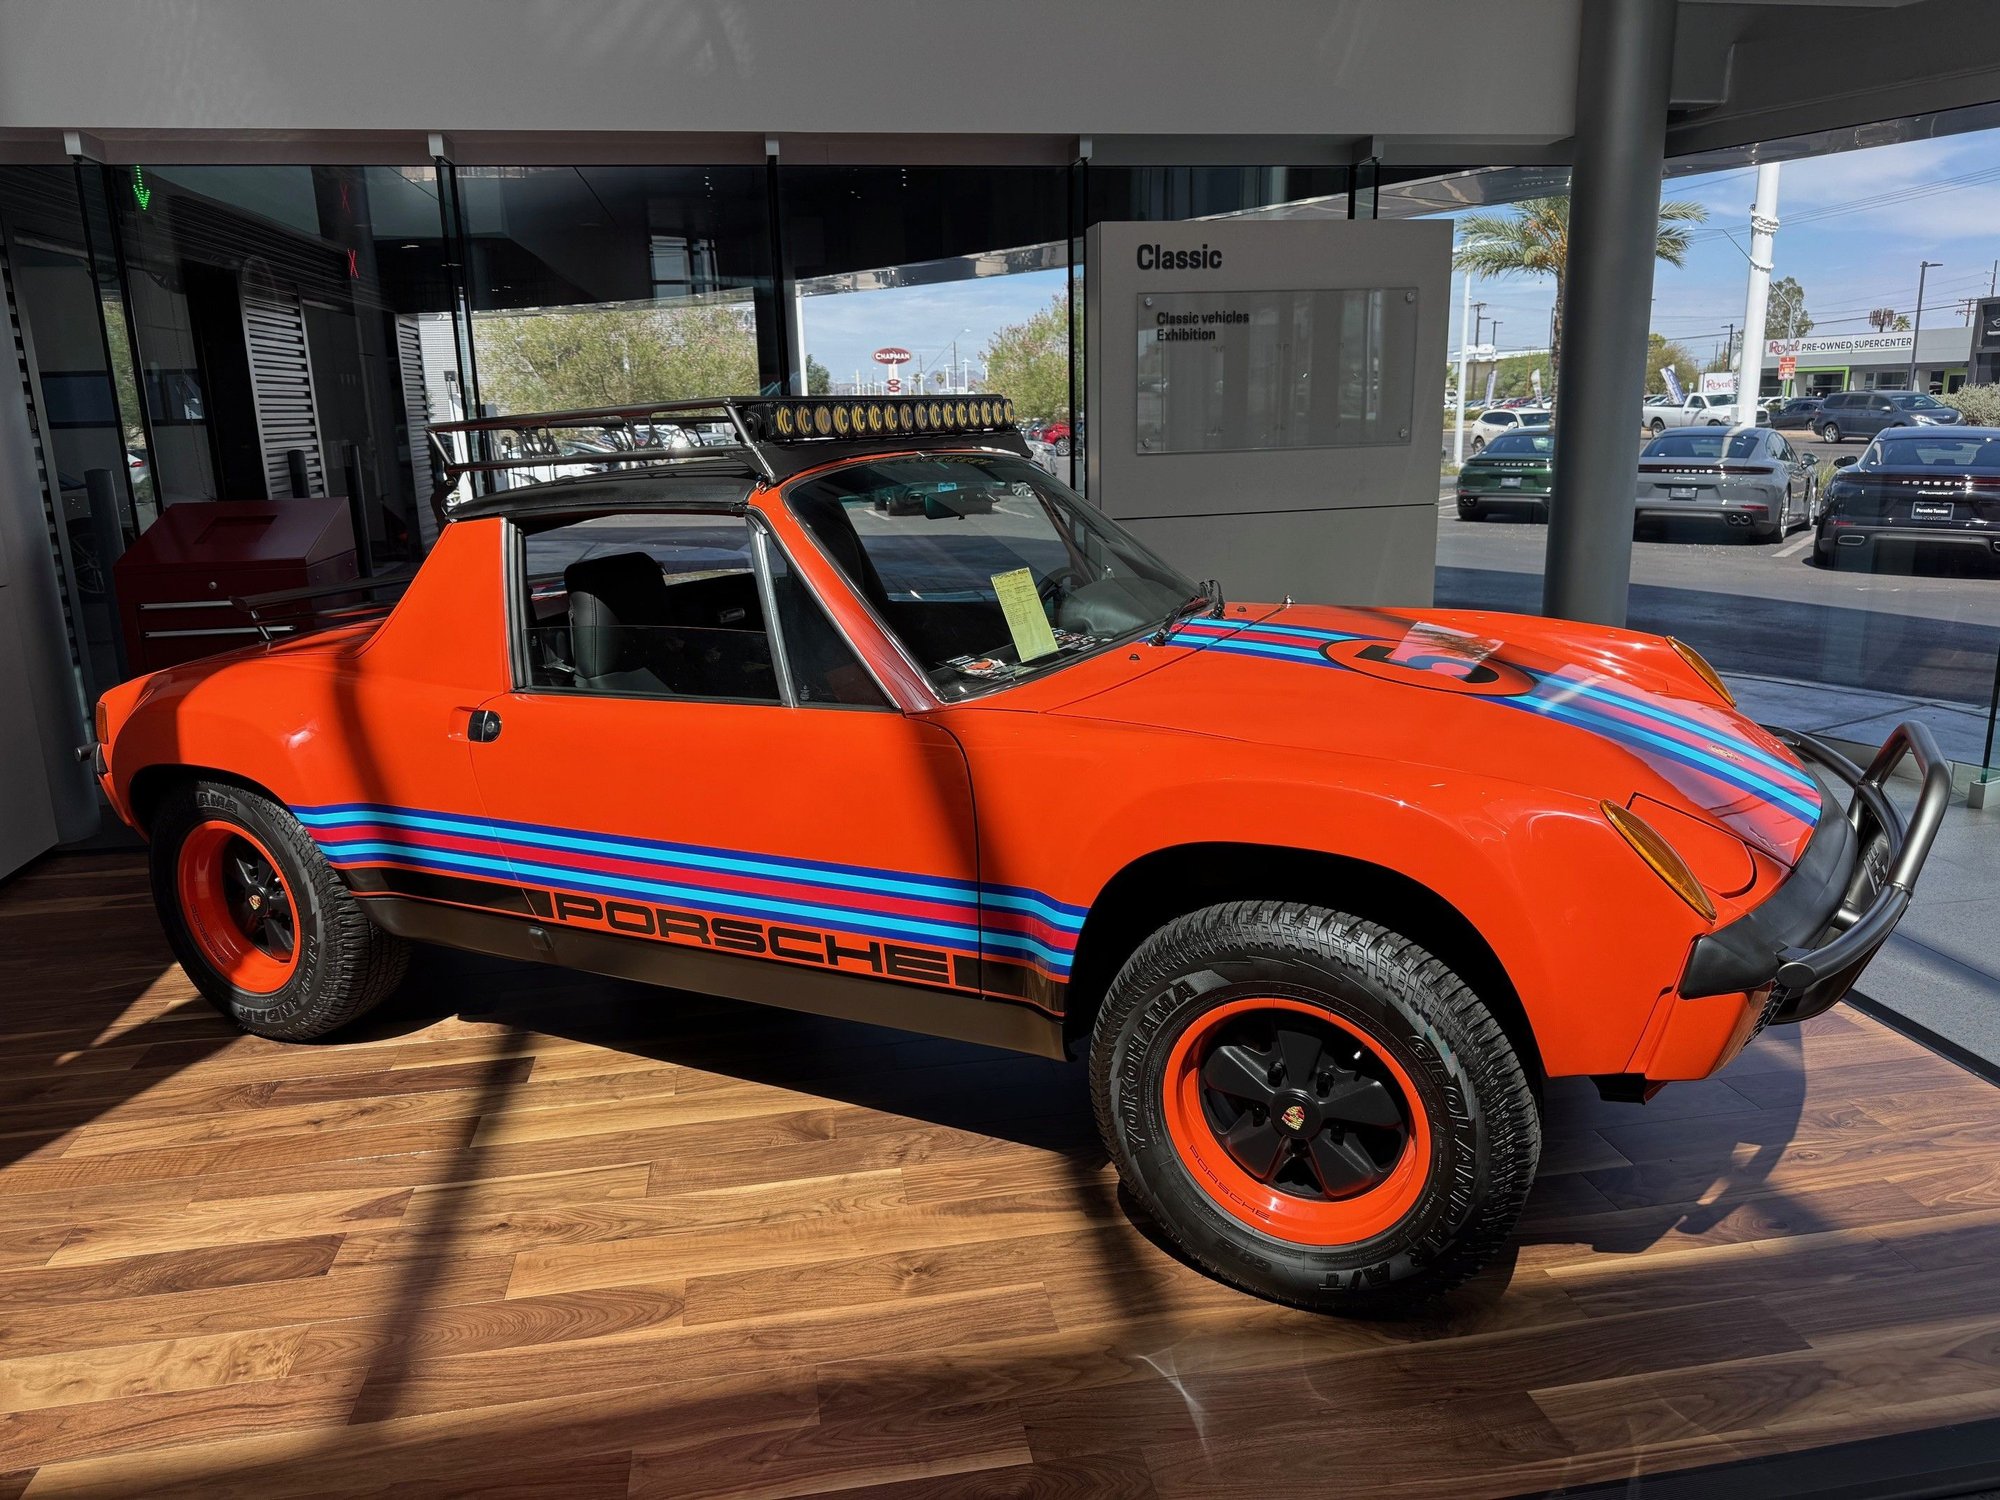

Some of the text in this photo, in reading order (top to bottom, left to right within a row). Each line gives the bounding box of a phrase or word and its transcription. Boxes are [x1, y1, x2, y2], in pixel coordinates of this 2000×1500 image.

[1136, 243, 1223, 270] Classic
[1156, 310, 1250, 325] Classic vehicles
[1156, 327, 1216, 341] Exhibition
[1801, 341, 1852, 352] PRE-OWNED
[1854, 337, 1913, 349] SUPERCENTER
[875, 352, 910, 360] CHAPMAN
[777, 401, 1013, 433] KC KC KC KC KC KC KC KC KC KC KC KC KC KC KC KC
[1354, 645, 1500, 684] 5
[554, 891, 950, 983] PORSCHE
[1119, 979, 1199, 1154] YOKOHAMA
[1189, 1144, 1271, 1221] PORSCHE
